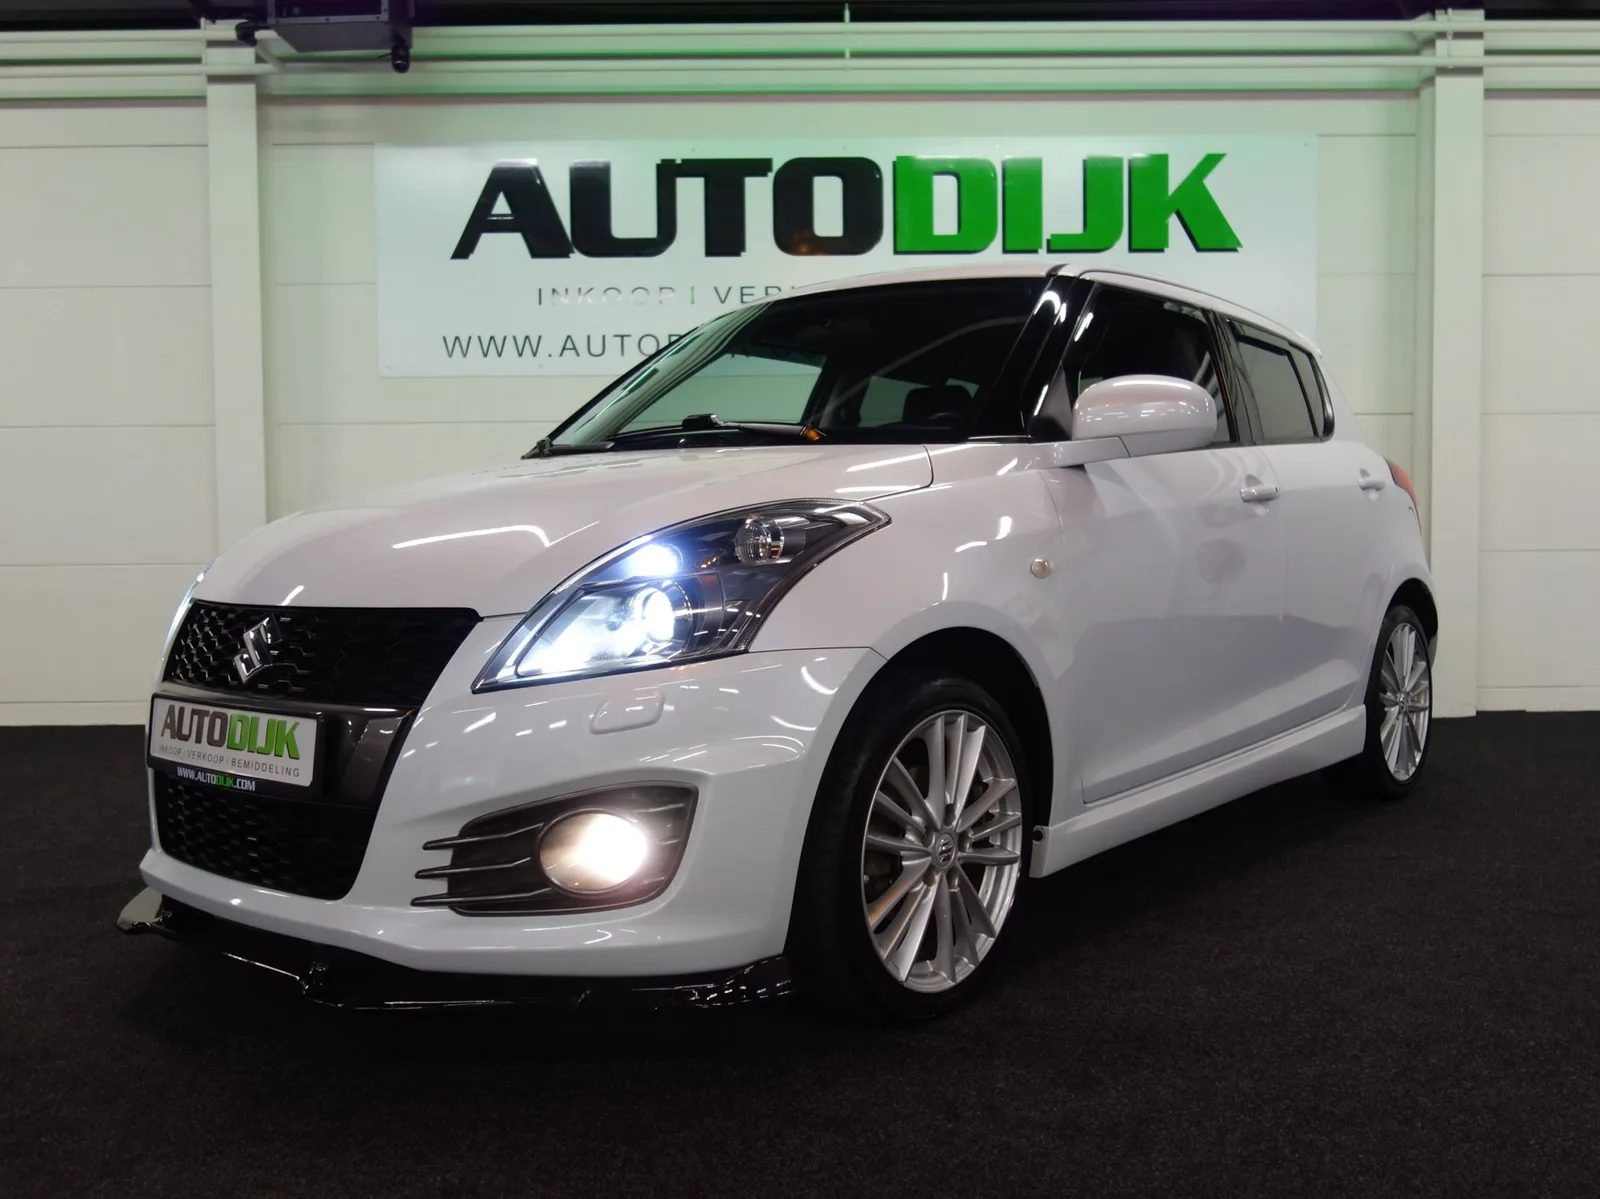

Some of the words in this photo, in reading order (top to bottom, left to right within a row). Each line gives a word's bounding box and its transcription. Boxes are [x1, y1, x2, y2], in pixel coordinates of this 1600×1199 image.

[450, 153, 1243, 259] AUTODIJK
[160, 704, 300, 760] AUTODIJK
[177, 766, 256, 792] WWW.AUTODIJK.COM
[187, 749, 224, 763] VERKOOP
[231, 758, 300, 778] BEMIDDELING
